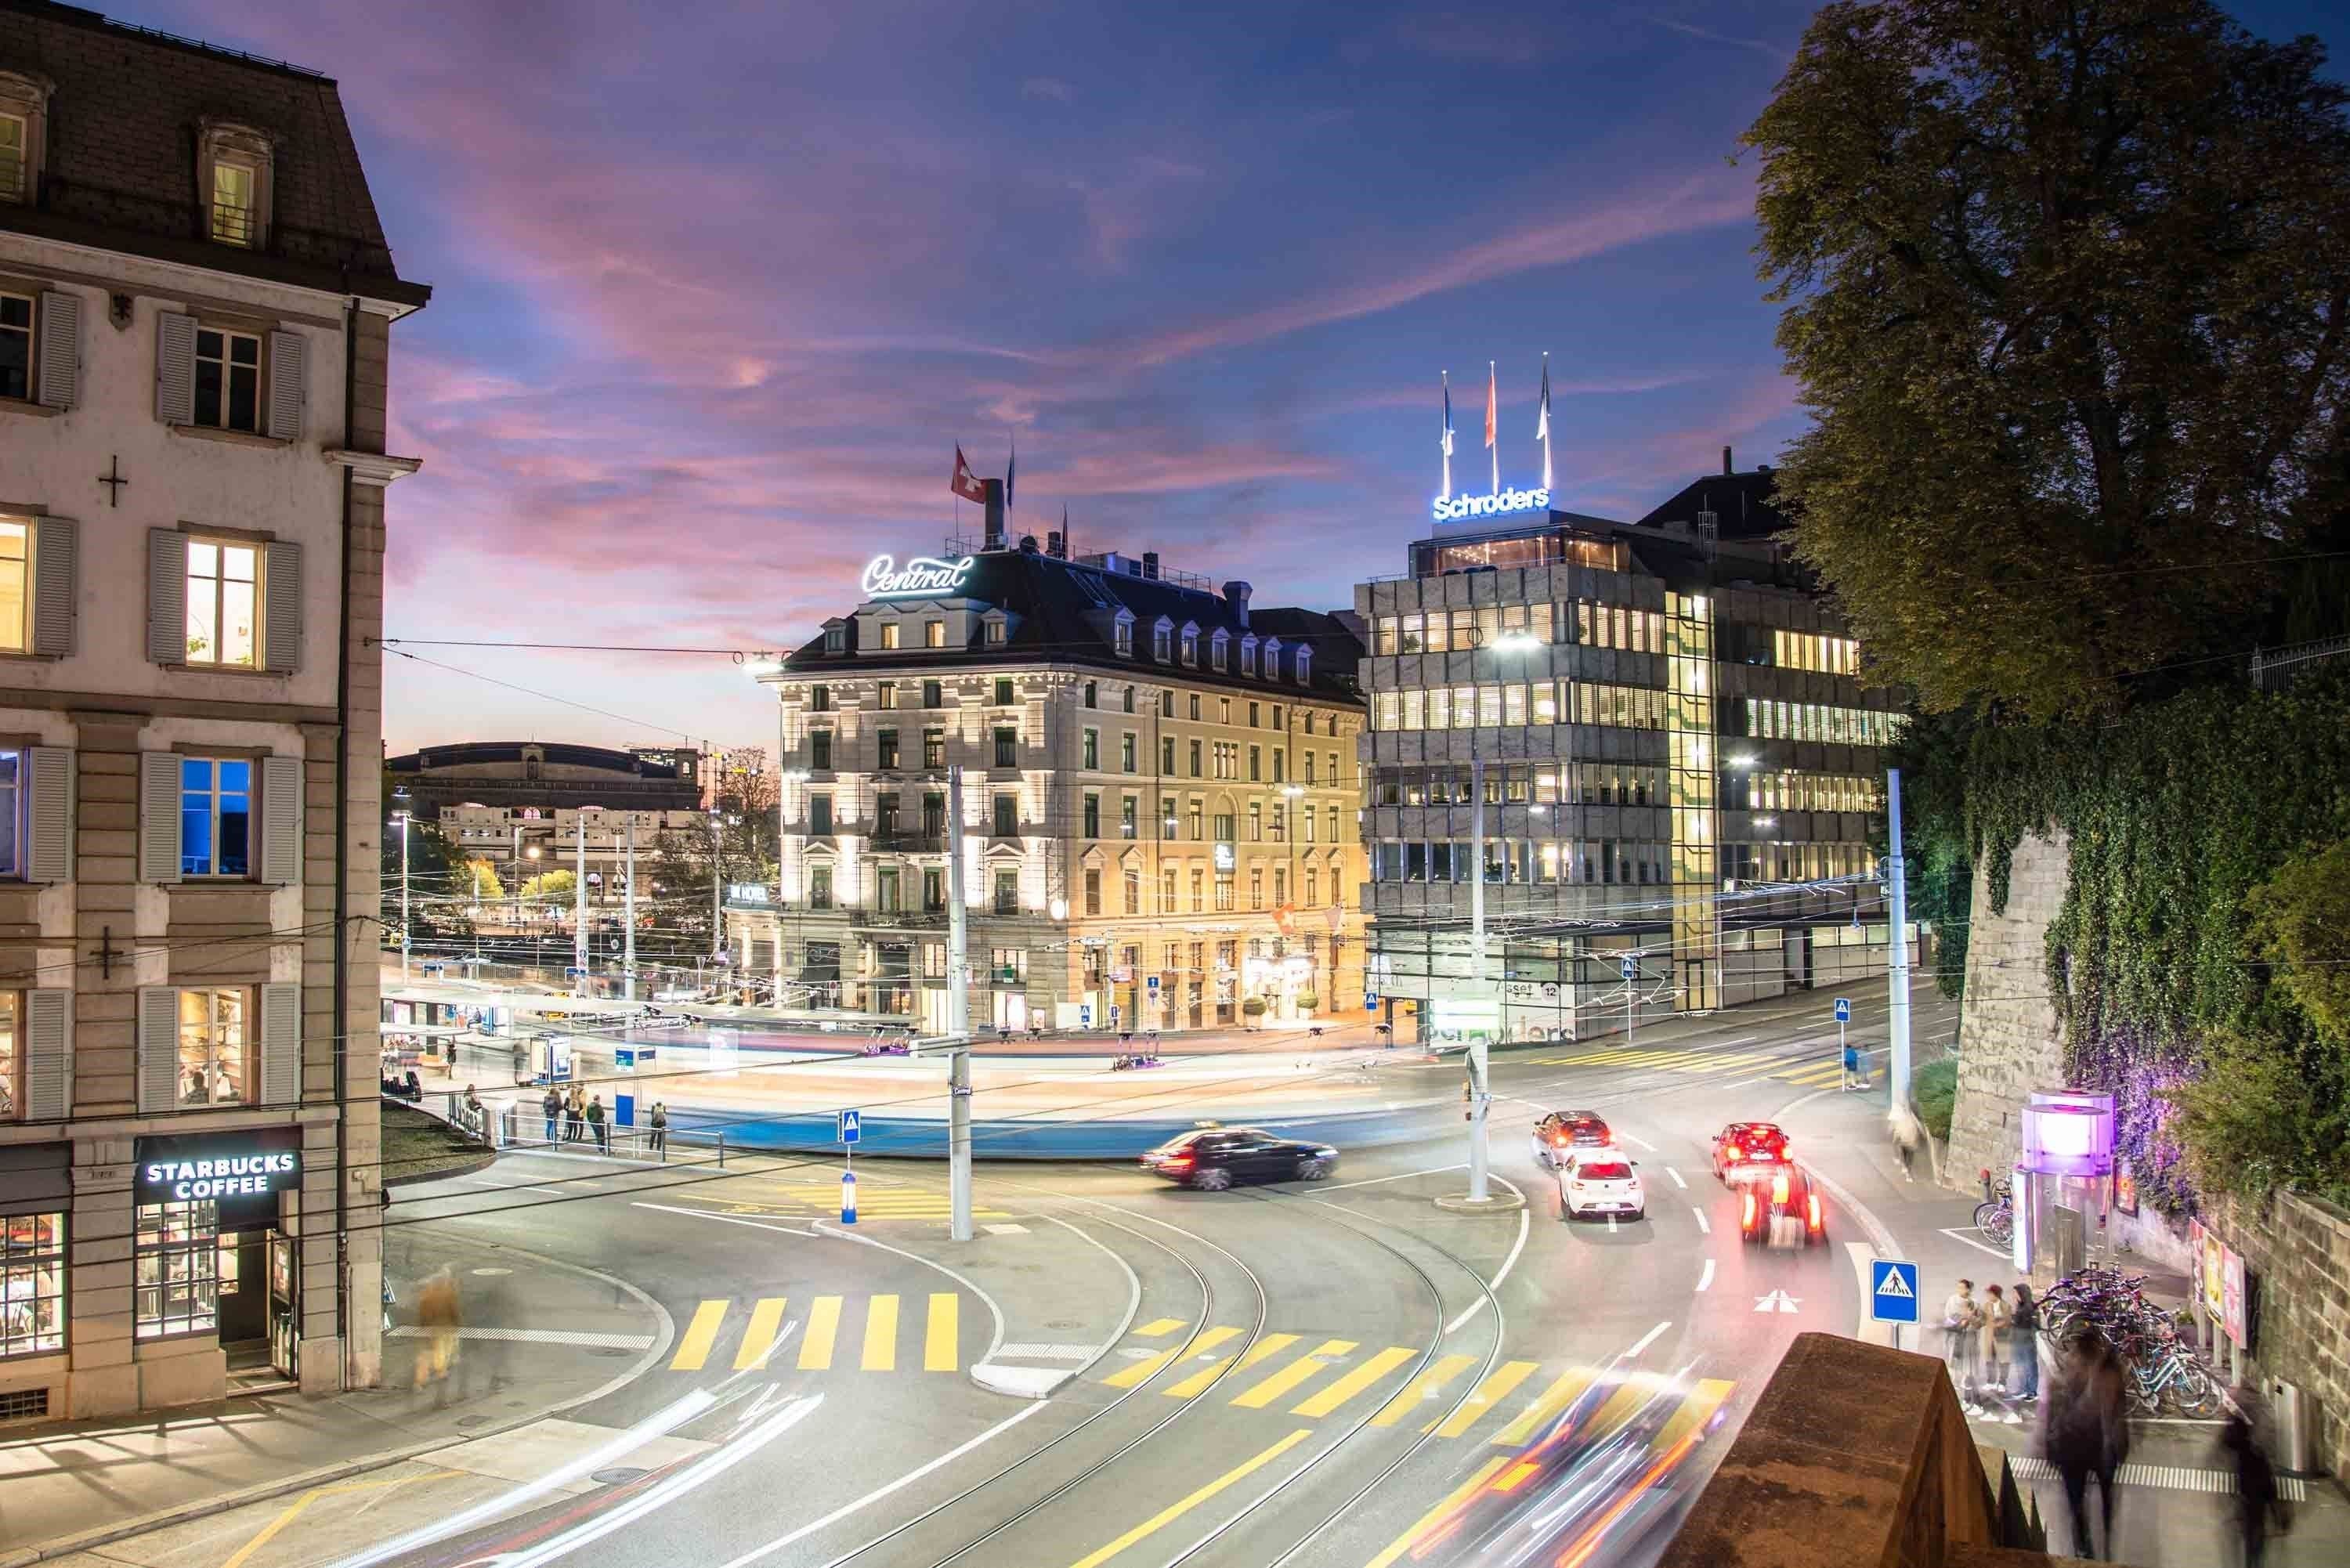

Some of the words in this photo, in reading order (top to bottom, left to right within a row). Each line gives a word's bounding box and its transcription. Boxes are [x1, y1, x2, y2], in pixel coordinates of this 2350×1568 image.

[1434, 486, 1549, 520] Schroders
[862, 555, 974, 594] Central
[1546, 987, 1556, 997] 12
[146, 1154, 295, 1182] STARBUCKS
[175, 1176, 268, 1199] COFFEE
